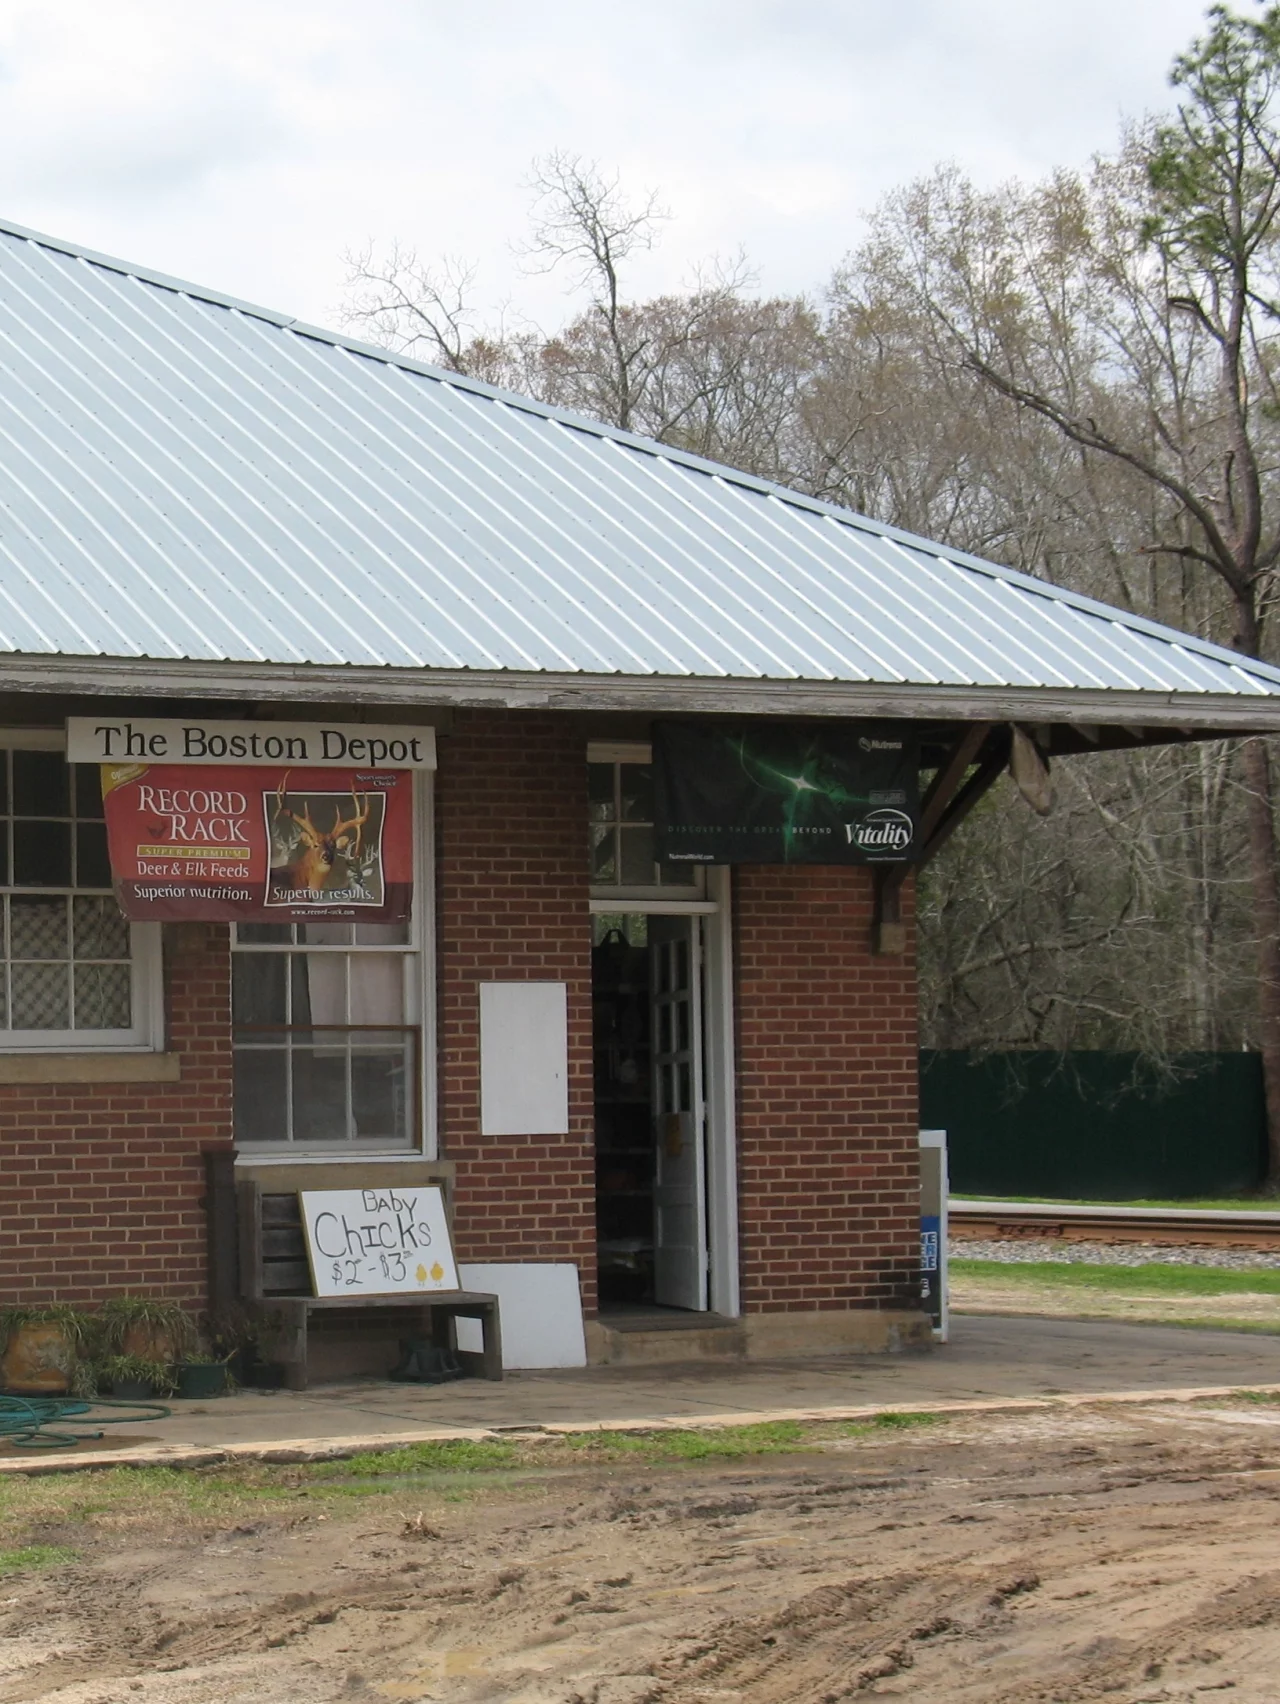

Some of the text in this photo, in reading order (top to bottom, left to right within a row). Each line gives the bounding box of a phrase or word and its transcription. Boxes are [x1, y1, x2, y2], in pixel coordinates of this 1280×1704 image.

[95, 723, 424, 767] The Boston Depot
[137, 785, 247, 816] RECORD
[169, 813, 249, 842] RACK
[792, 826, 832, 834] BEYOND
[845, 822, 913, 851] Vitality
[145, 847, 242, 859] SUPER PREMIUM
[137, 861, 249, 878] Deer & Elk Feeds
[133, 884, 252, 902] Superior nutrition.
[272, 887, 375, 902] Superior results.
